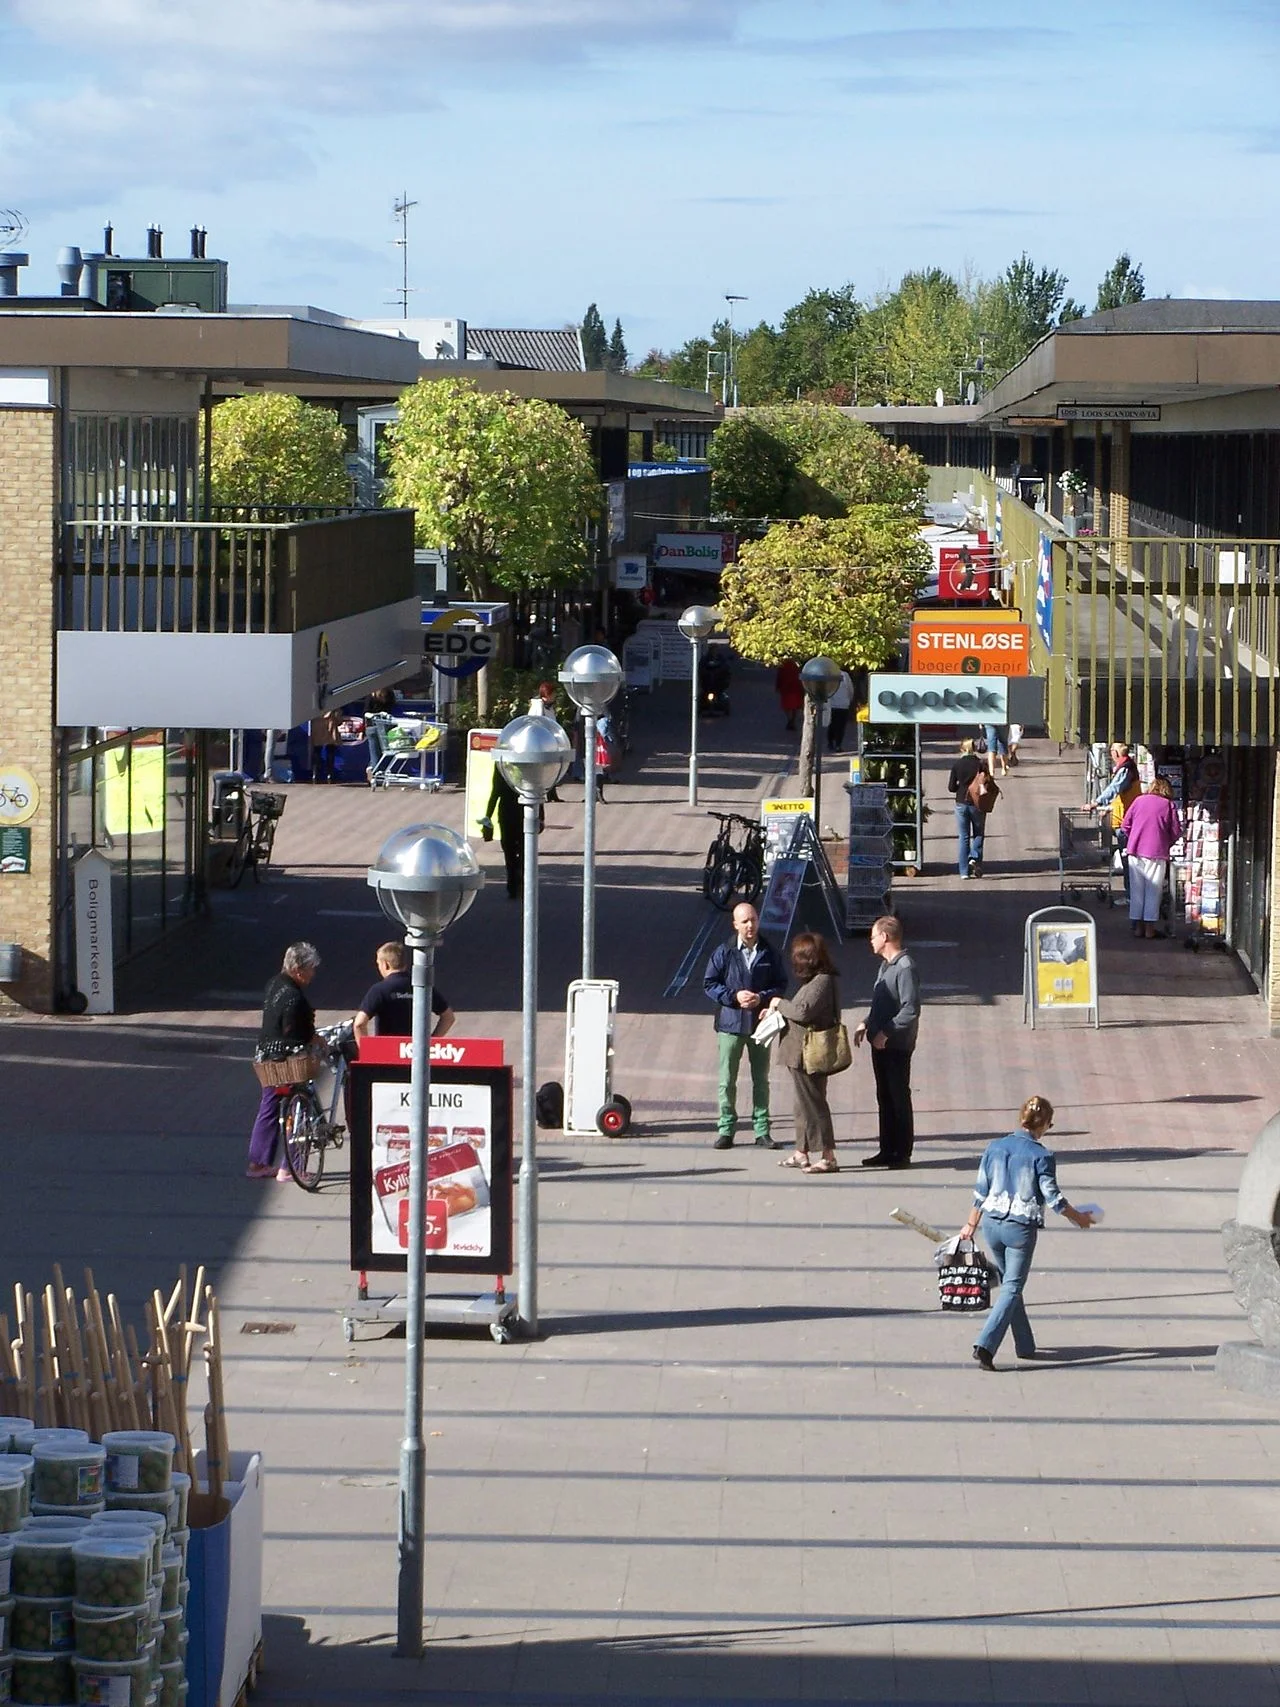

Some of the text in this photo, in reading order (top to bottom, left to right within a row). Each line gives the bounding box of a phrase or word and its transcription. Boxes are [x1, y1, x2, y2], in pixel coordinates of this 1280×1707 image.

[660, 545, 719, 559] DanBolig
[424, 633, 492, 654] EDC
[917, 633, 1024, 650] STENLØSE
[917, 660, 1022, 673] bøger & papir
[878, 686, 1001, 714] apotek
[87, 879, 101, 996] Boligmarkedet
[400, 1092, 463, 1108] KLING
